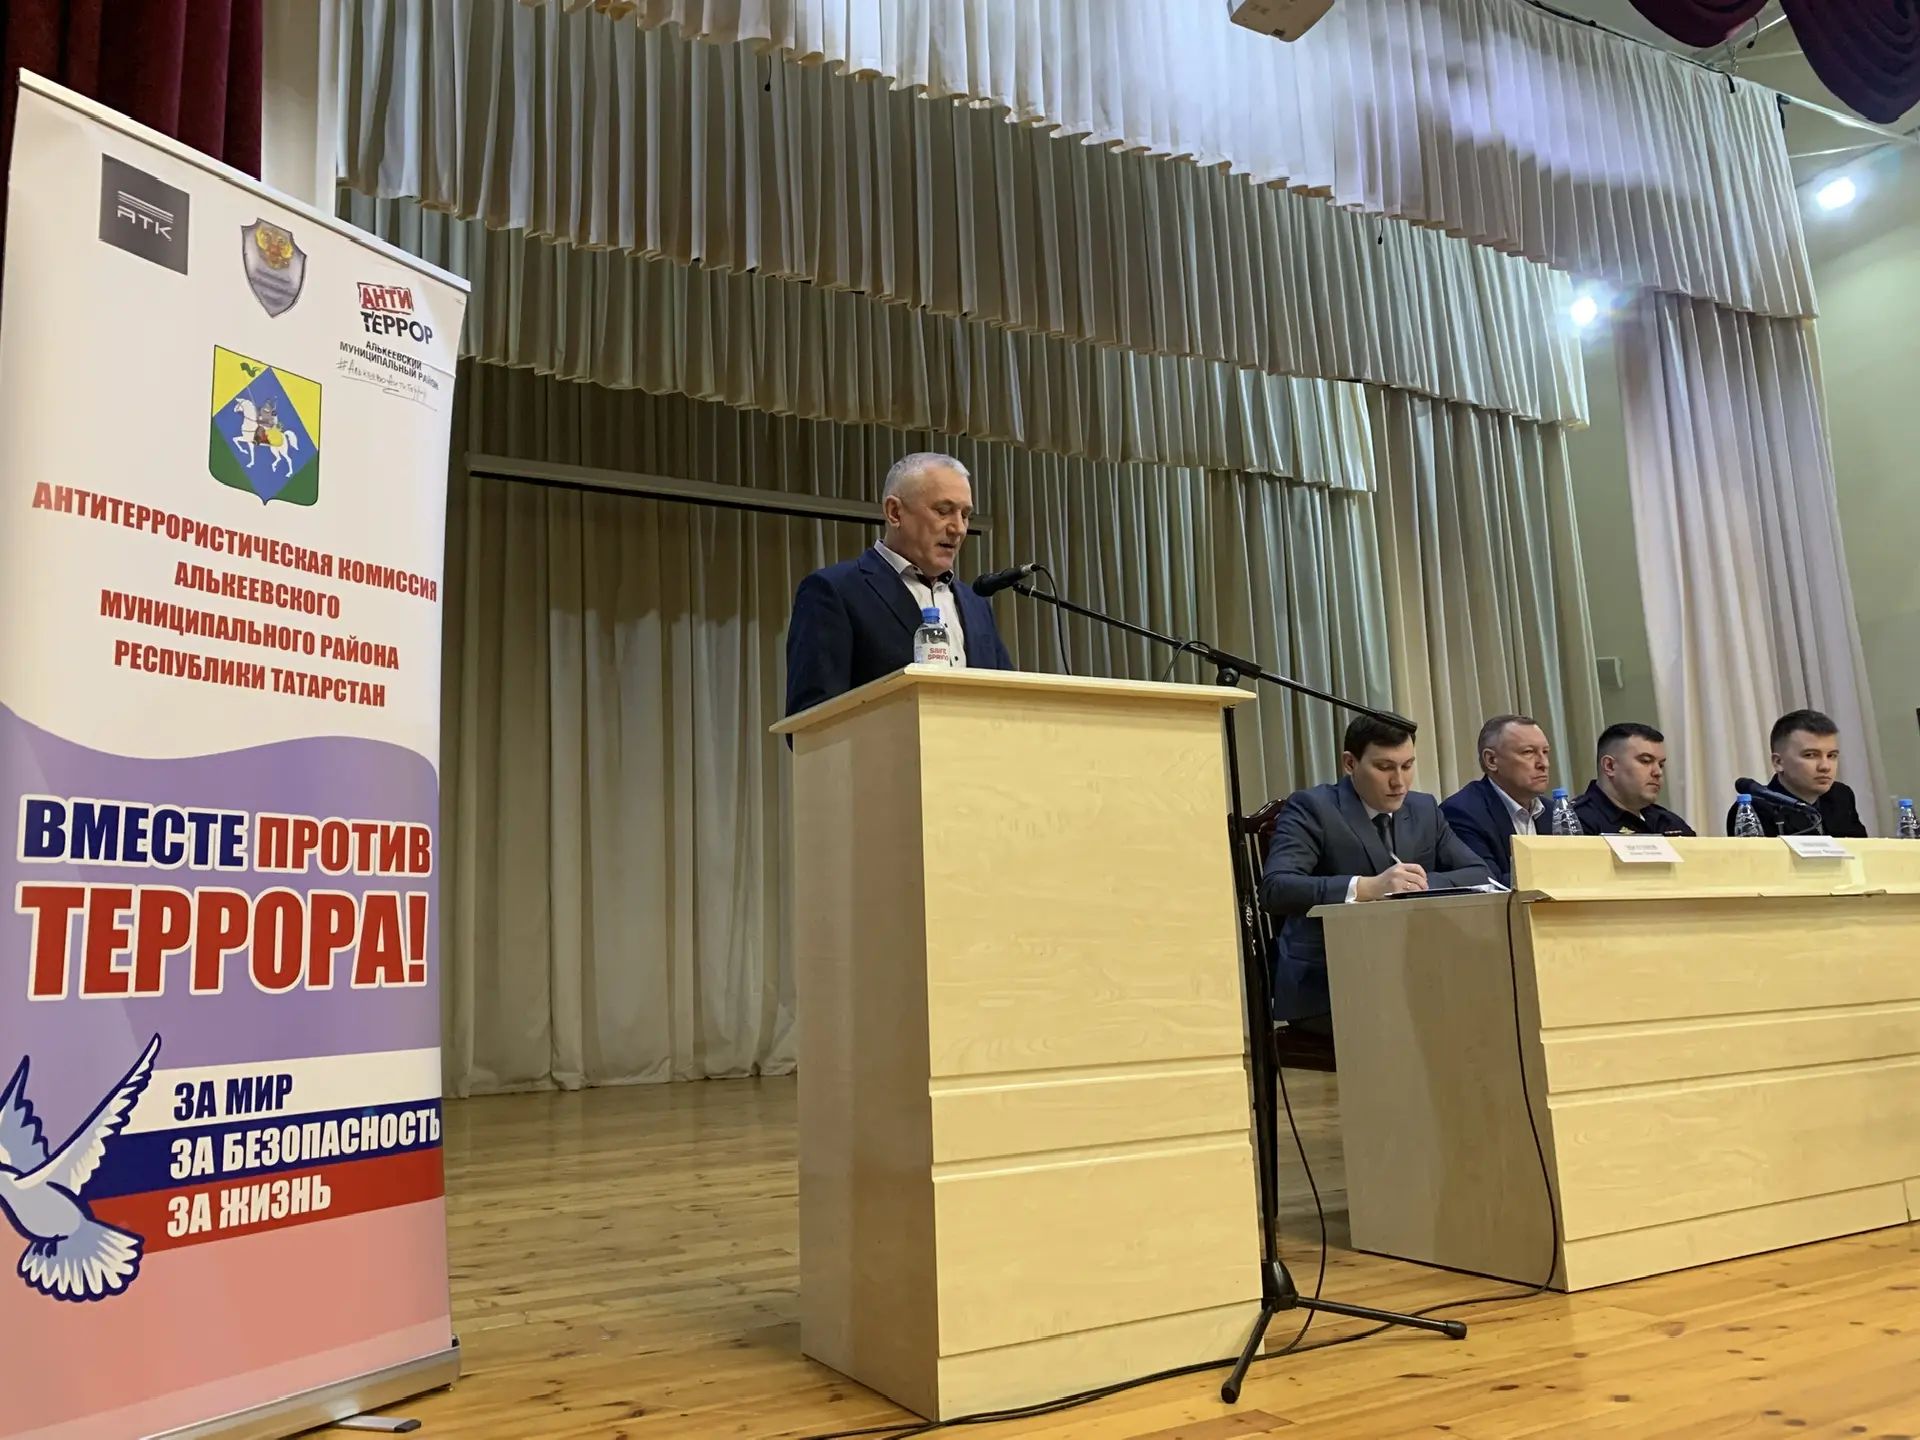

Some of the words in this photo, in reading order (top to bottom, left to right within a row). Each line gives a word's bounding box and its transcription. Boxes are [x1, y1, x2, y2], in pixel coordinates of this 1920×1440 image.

[360, 311, 433, 345] ТЕРРОР
[361, 286, 412, 311] АНТИ
[339, 341, 417, 379] МУНИЦИПАЛЬНЫЙ
[365, 340, 423, 371] АЛЬКЕЕВСКИЙ
[32, 482, 333, 577] АНТИТЕРРОРИСТИЧЕСКАЯ
[338, 556, 438, 603] КОМИССИЯ
[174, 561, 341, 620] АЛЬКЕЕВСКОГО
[100, 589, 316, 656] МУНИЦИПАЛЬНОГО
[320, 634, 400, 671] РАЙОНА
[114, 640, 266, 691] РЕСПУБЛИКИ
[271, 667, 386, 708] ТАТАРСТАН
[21, 798, 246, 868] ВМЕСТЕ
[256, 815, 432, 875] ПРОТИВ
[18, 884, 428, 997] ТЕРРОРА!
[173, 1080, 217, 1122] ЗА
[225, 1073, 293, 1116] МИР
[169, 1135, 216, 1180] ЗА
[222, 1107, 441, 1173] БЕЗОПАСНОСТЬ
[166, 1195, 213, 1239] ЗА
[218, 1173, 332, 1230] ЖИЗНЬ
